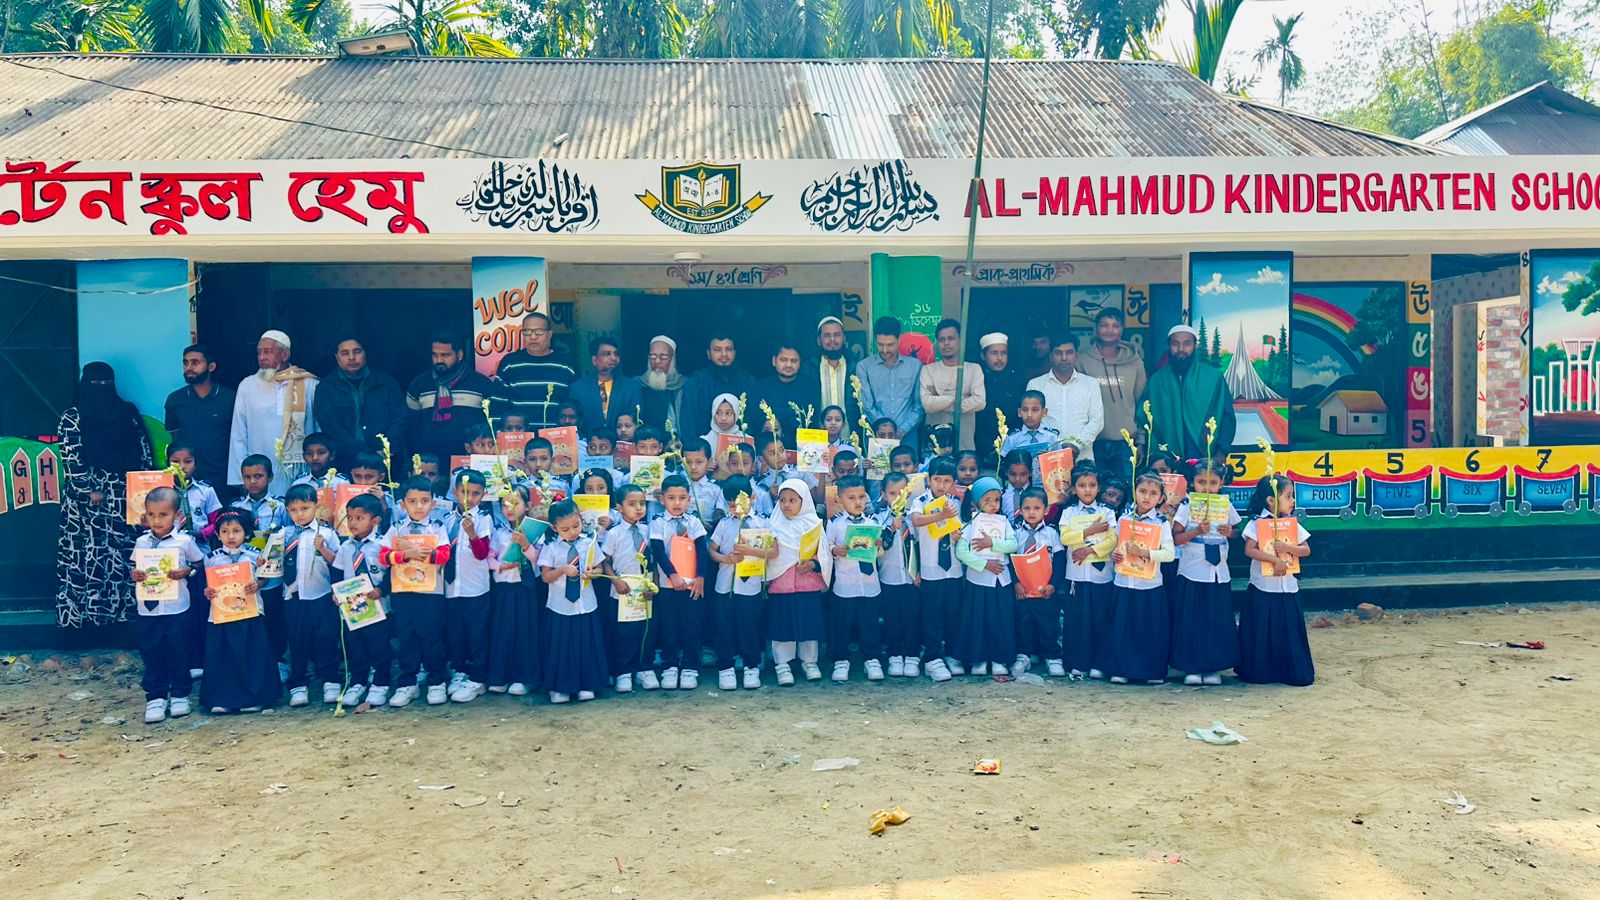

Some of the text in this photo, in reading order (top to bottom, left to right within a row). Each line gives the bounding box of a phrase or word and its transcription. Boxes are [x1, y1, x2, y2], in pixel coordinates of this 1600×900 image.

[288, 171, 430, 234] হেমু
[965, 173, 1215, 218] AL-MAHMUD
[1225, 172, 1496, 213] KINDERGARTEN
[687, 218, 735, 234] KINDERGARTEN
[475, 279, 538, 324] wel
[14, 460, 27, 477] G
[40, 457, 54, 476] H
[1230, 454, 1246, 477] 3
[1314, 452, 1334, 477] 4
[1387, 453, 1404, 474] 5
[1466, 450, 1480, 472] 6
[1536, 449, 1552, 472] 7
[1312, 489, 1340, 501] FOUR
[1385, 487, 1411, 498] FIVE
[1463, 484, 1482, 496] SIX
[1537, 484, 1567, 495] SEVEN
